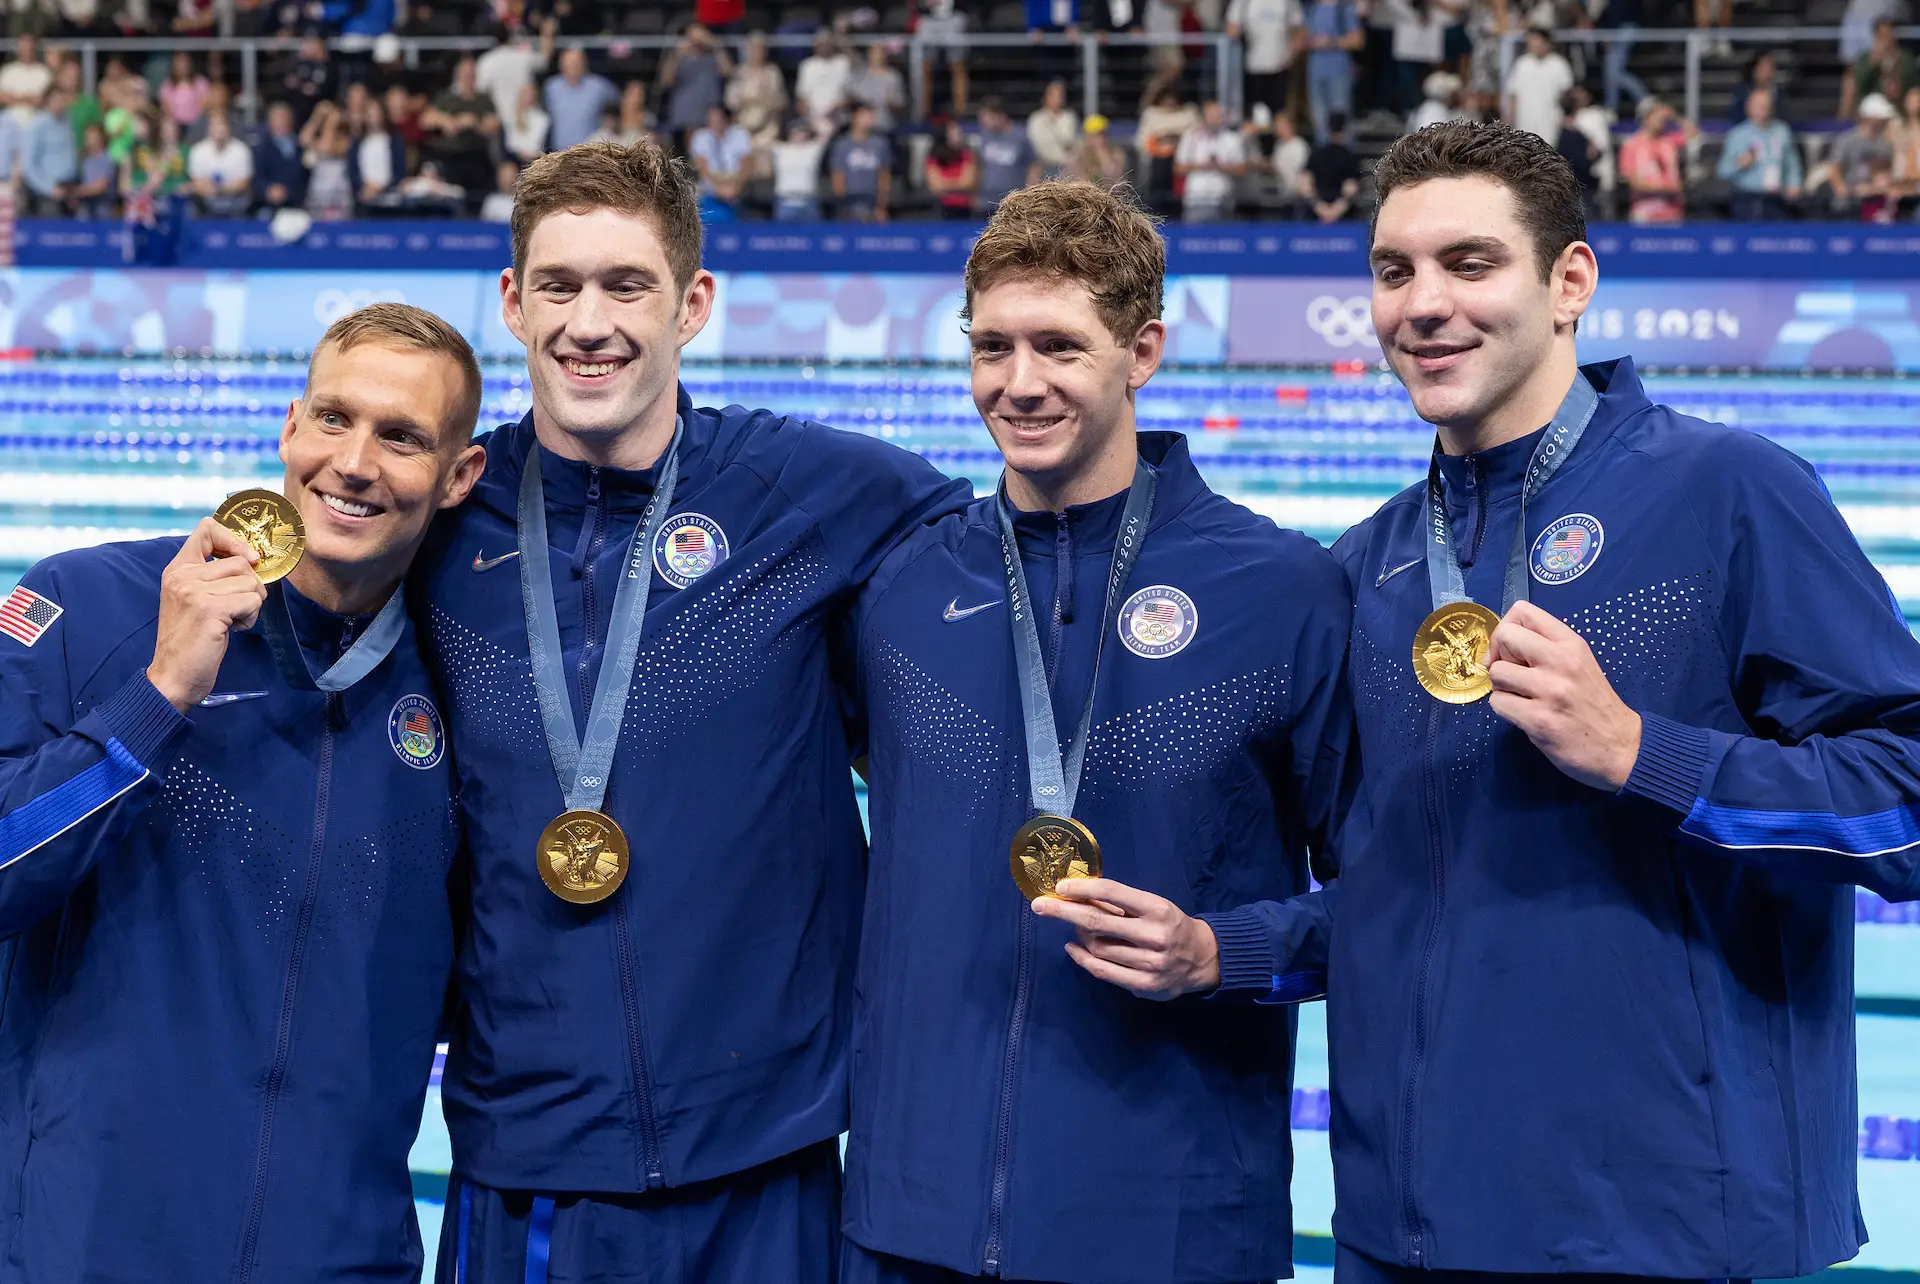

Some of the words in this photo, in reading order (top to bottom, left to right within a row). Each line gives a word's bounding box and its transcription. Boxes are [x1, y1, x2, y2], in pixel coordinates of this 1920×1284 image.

[1633, 308, 1740, 341] 2024
[1540, 426, 1569, 466] 2024
[661, 517, 687, 537] UNITED
[689, 517, 717, 535] STATES
[1120, 516, 1139, 558] 2024
[1434, 505, 1446, 545] PARIS
[1546, 518, 1574, 536] UNITED
[1576, 517, 1598, 534] STATES
[628, 532, 646, 578] PARIS
[1534, 564, 1560, 580] OLYMPIC
[1564, 562, 1585, 579] TEAM
[1009, 577, 1024, 622] PARIS
[1132, 589, 1161, 605] UNITED
[1164, 590, 1190, 611] STATES
[1126, 633, 1156, 654] OLYMPIC
[1159, 639, 1181, 653] TEAM
[395, 743, 421, 765] OLYMPIC
[422, 751, 438, 766] TEAM
